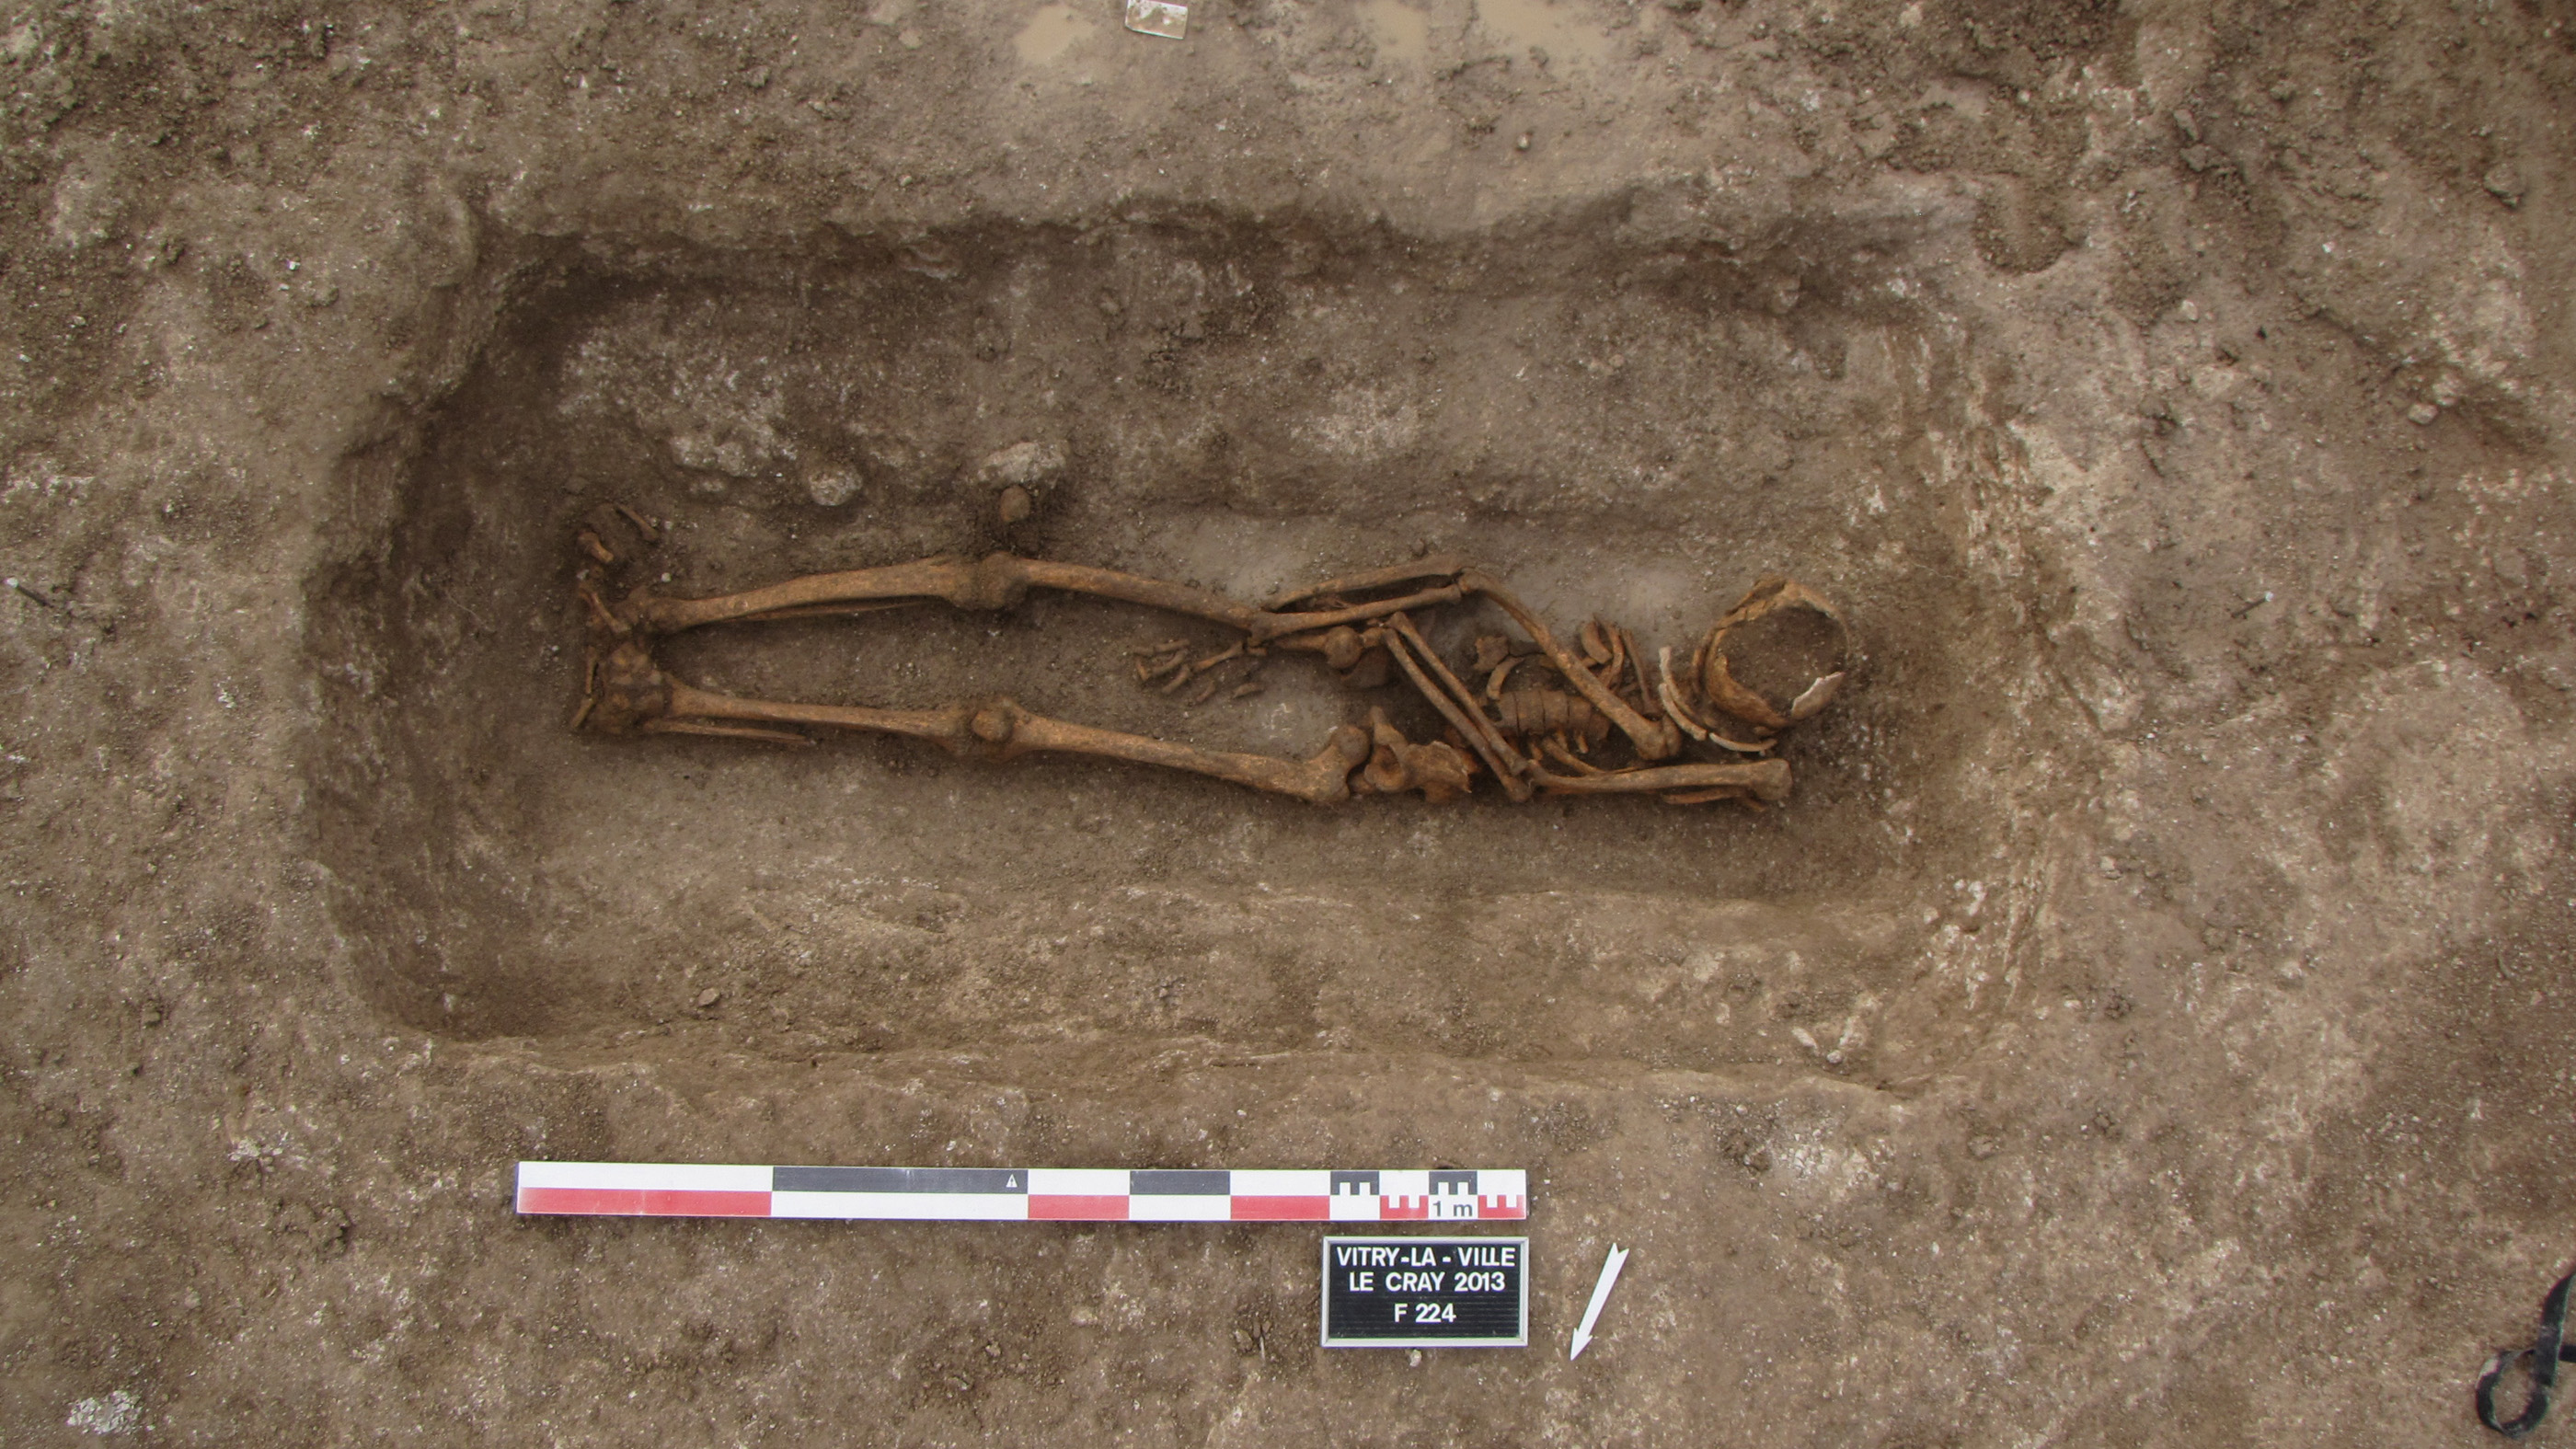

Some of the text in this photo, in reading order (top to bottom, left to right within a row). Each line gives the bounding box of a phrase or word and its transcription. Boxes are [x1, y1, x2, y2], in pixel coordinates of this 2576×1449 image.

[1432, 1201, 1473, 1216] 1 m
[1349, 1271, 1505, 1292] LE CRAY 2013
[1394, 1303, 1456, 1322] F 224
